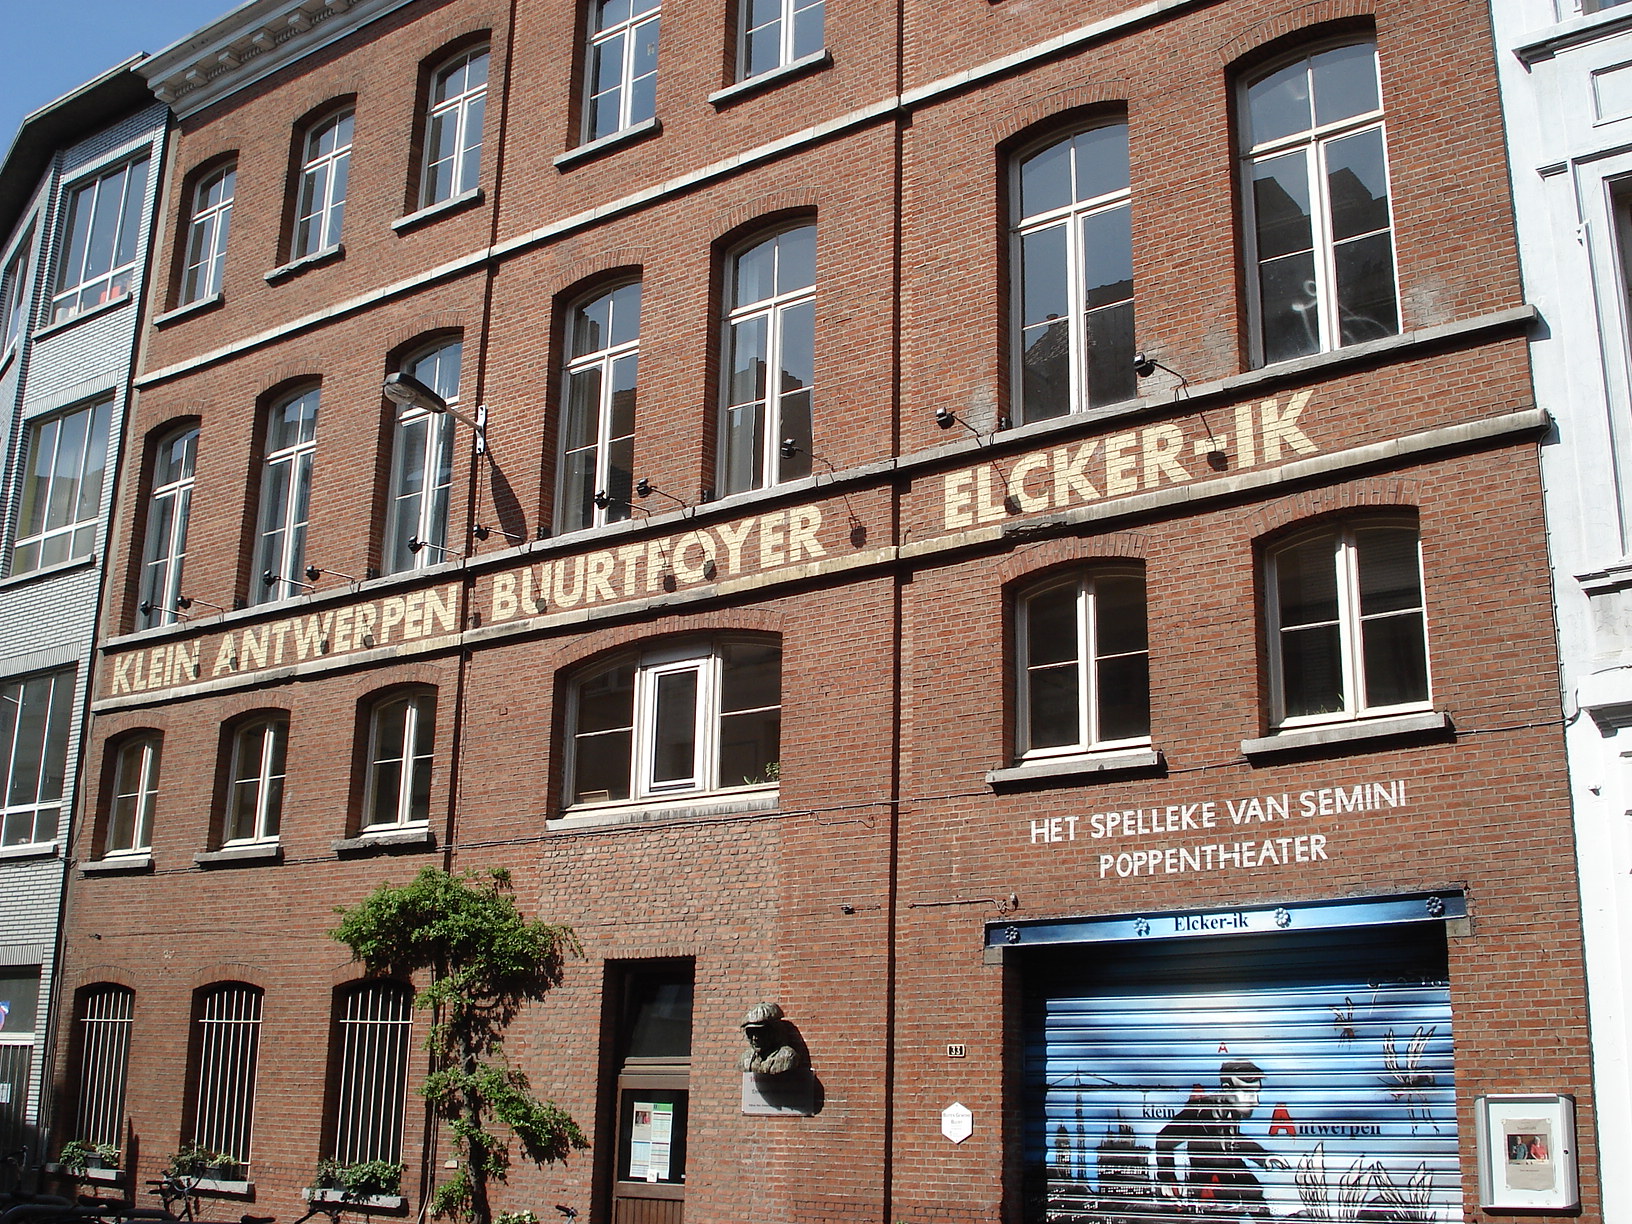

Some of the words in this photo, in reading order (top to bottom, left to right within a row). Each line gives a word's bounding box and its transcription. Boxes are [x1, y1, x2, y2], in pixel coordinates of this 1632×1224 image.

[112, 640, 201, 694] KLEIN
[212, 586, 457, 676] ANTWERPEN
[491, 505, 826, 622] BUURTFOYER
[944, 389, 1319, 530] ELCKER-IK
[1030, 815, 1079, 843] HET
[1090, 801, 1216, 839] SPELLEKE
[1225, 793, 1289, 825] VAN
[1300, 780, 1406, 818] SEMINI
[1099, 834, 1329, 879] POPPENTHEATER
[1174, 911, 1249, 933] Elcker-ik
[1142, 1105, 1175, 1118] klein
[1268, 1102, 1381, 1140] Antwerpen
